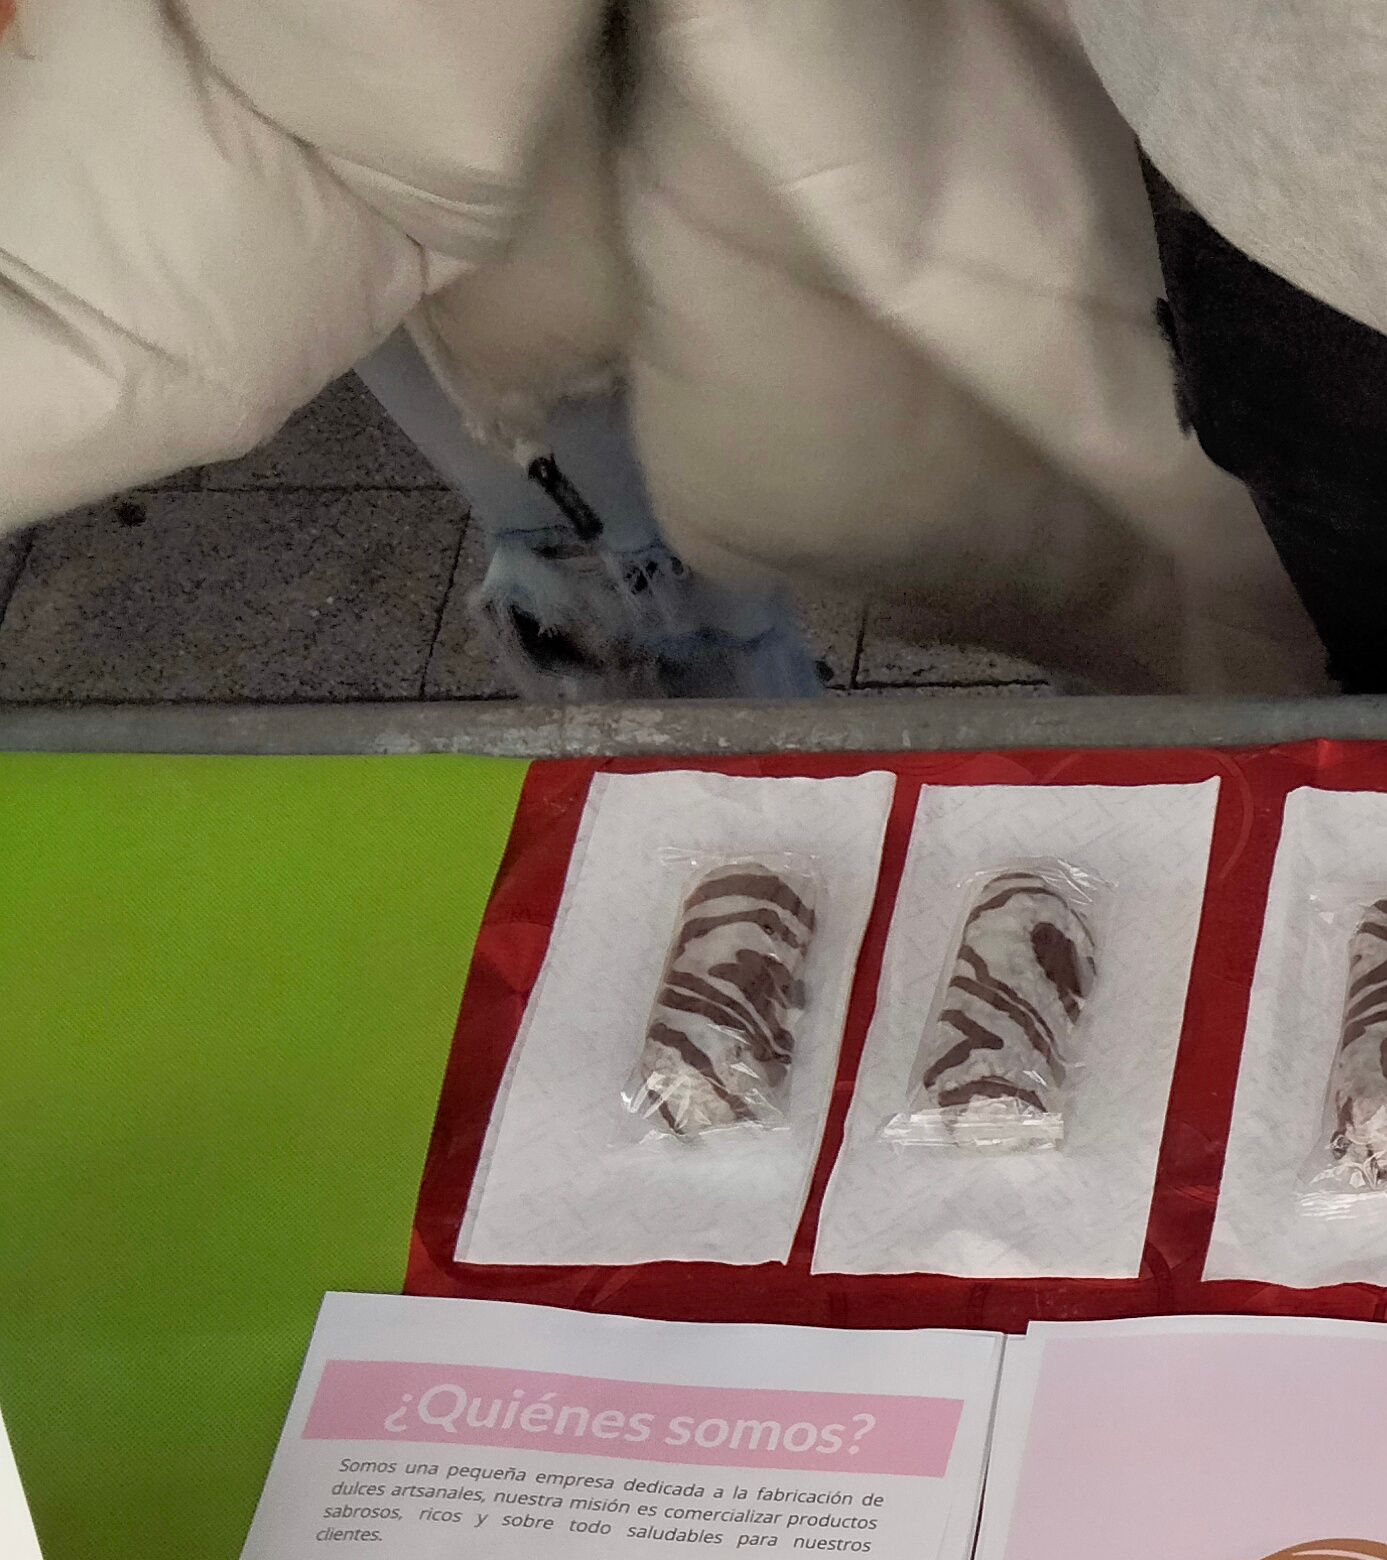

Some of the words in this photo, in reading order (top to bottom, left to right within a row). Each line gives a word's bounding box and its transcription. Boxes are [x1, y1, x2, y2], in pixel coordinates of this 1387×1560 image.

[383, 1382, 654, 1443] ¿Quiénes
[667, 1412, 876, 1455] somos?
[331, 1482, 386, 1496] dulces
[391, 1484, 486, 1504] artsanales,
[494, 1491, 563, 1508] nuestra
[569, 1496, 630, 1514] misión
[637, 1504, 658, 1517] es
[664, 1508, 783, 1525] comercializar
[786, 1511, 877, 1530] productos
[339, 1458, 397, 1473] Somos
[405, 1463, 438, 1475] una
[446, 1463, 526, 1482] pequeña
[535, 1472, 614, 1490] empresa
[623, 1477, 705, 1498] dedicada
[712, 1487, 724, 1499] a
[732, 1485, 748, 1500] la
[756, 1486, 853, 1506] fabricación
[861, 1493, 884, 1507] de
[316, 1527, 383, 1542] clientes.
[323, 1505, 404, 1520] sabrosos,
[419, 1507, 463, 1523] ricos
[474, 1513, 488, 1527] y
[502, 1514, 554, 1530] sobre
[569, 1519, 612, 1535] todo
[626, 1525, 723, 1544] saludables
[736, 1533, 778, 1548] para
[793, 1536, 872, 1552] nuestros
